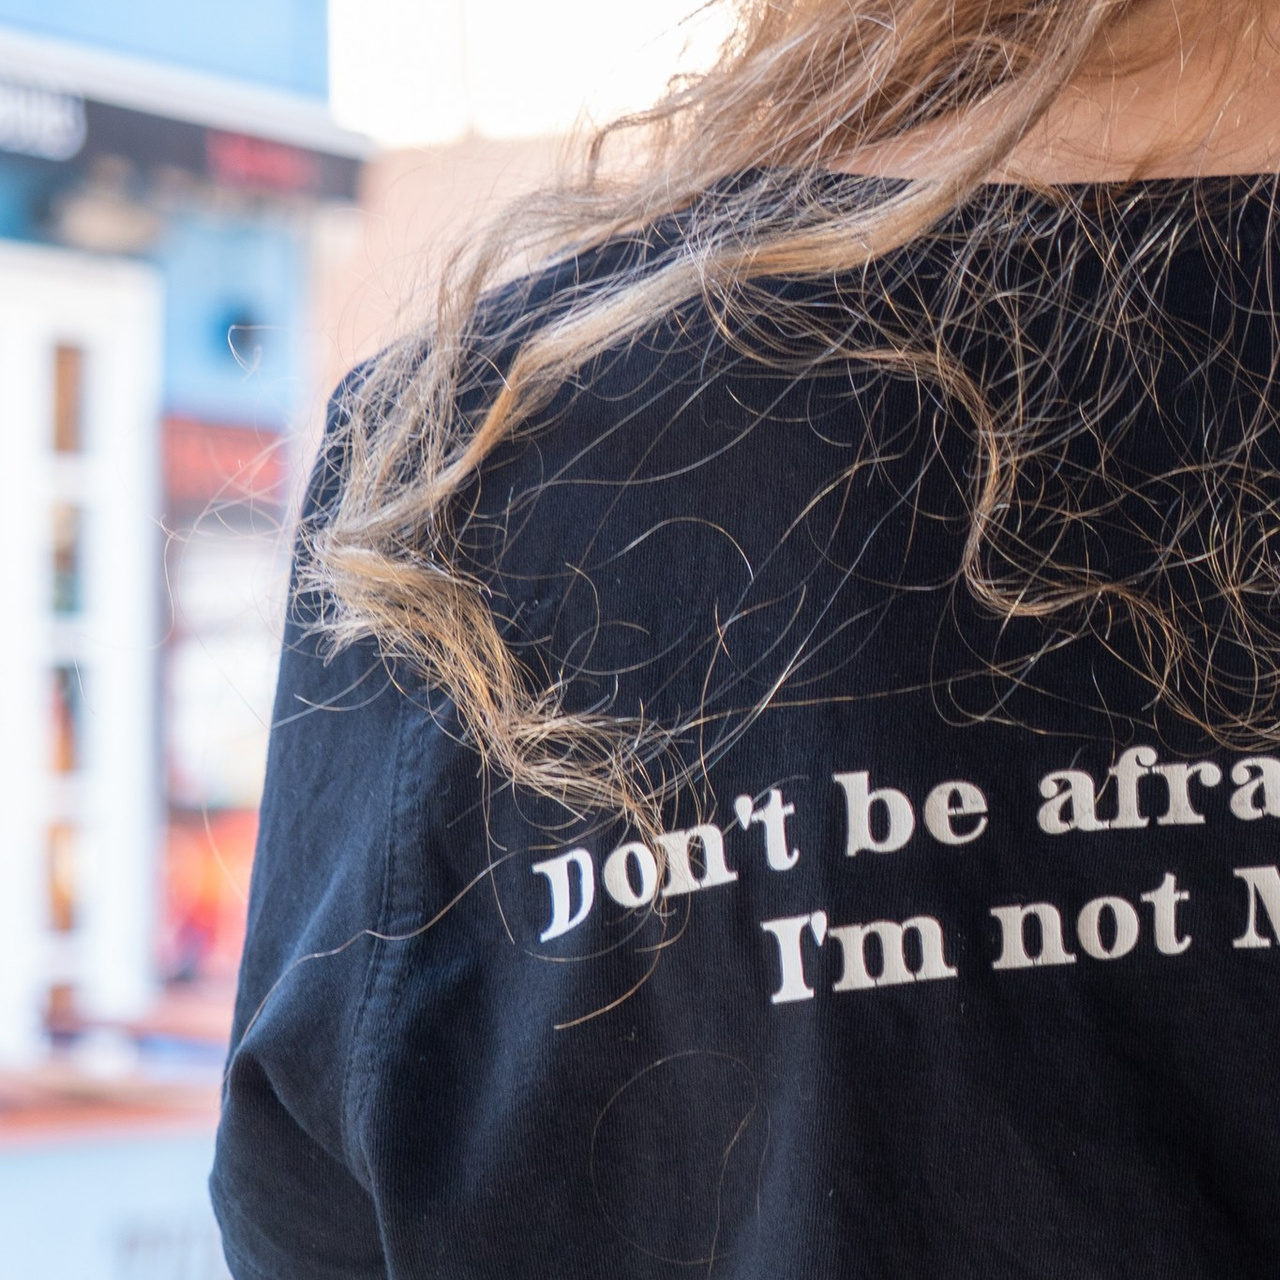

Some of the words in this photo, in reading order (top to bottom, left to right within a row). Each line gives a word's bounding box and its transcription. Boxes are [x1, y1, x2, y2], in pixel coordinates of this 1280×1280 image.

[532, 787, 800, 942] Don't
[833, 770, 988, 856] be
[760, 910, 958, 1005] I'm
[990, 872, 1192, 970] not
